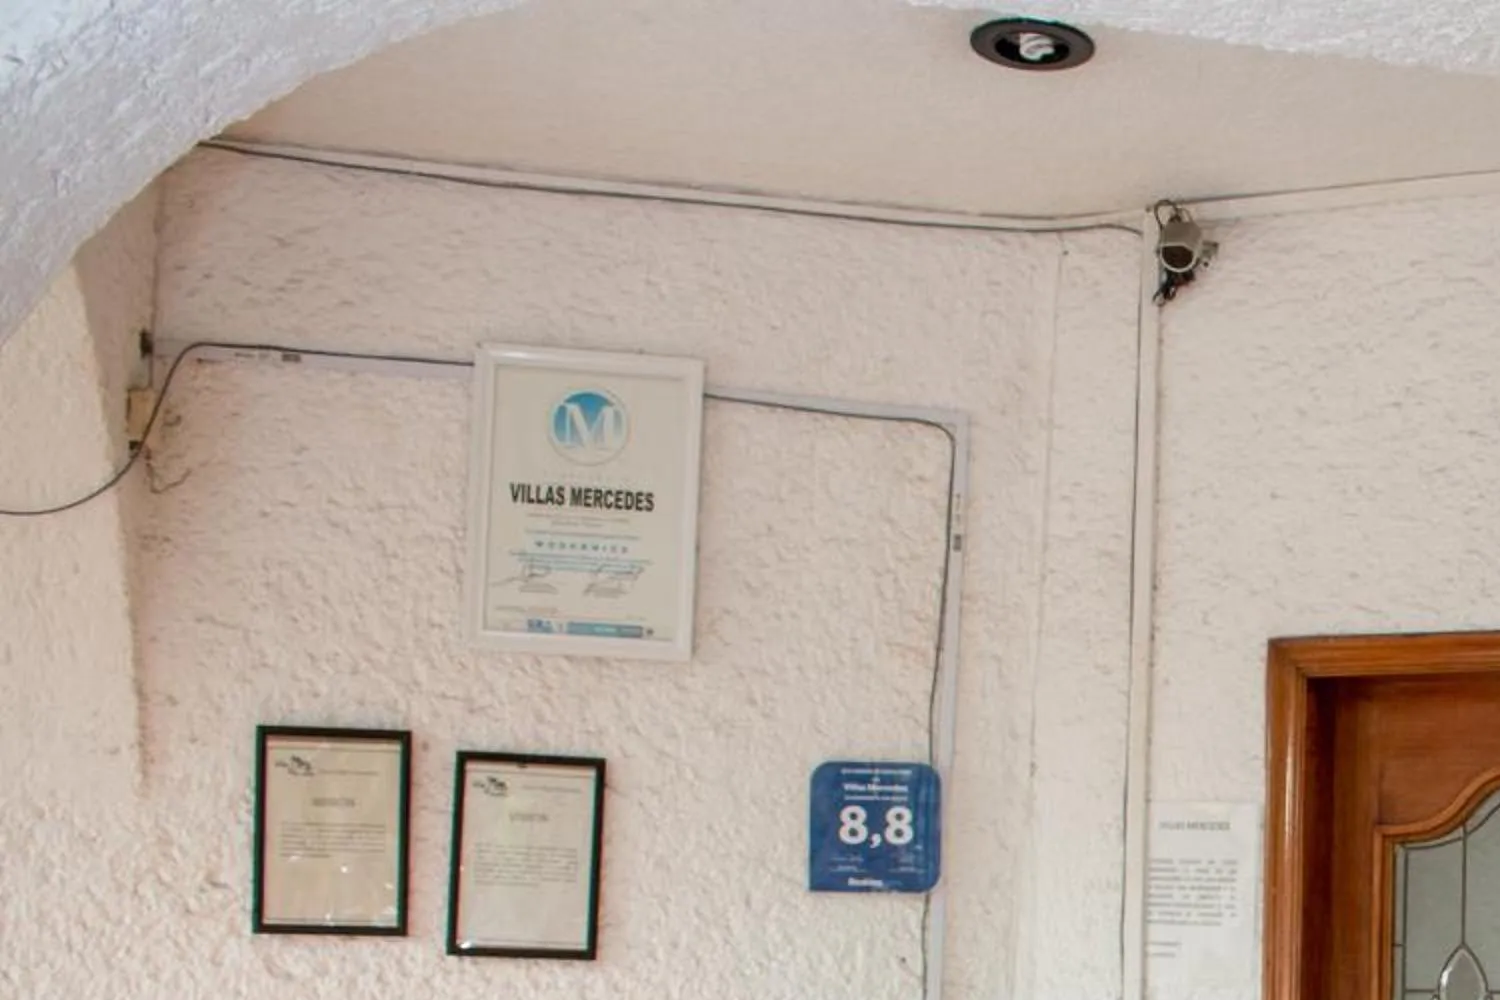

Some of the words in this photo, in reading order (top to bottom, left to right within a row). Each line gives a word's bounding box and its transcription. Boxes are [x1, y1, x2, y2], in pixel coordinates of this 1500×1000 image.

[509, 481, 565, 506] VILLAS
[569, 486, 655, 512] MERCEDES
[839, 805, 914, 849] 8,8
